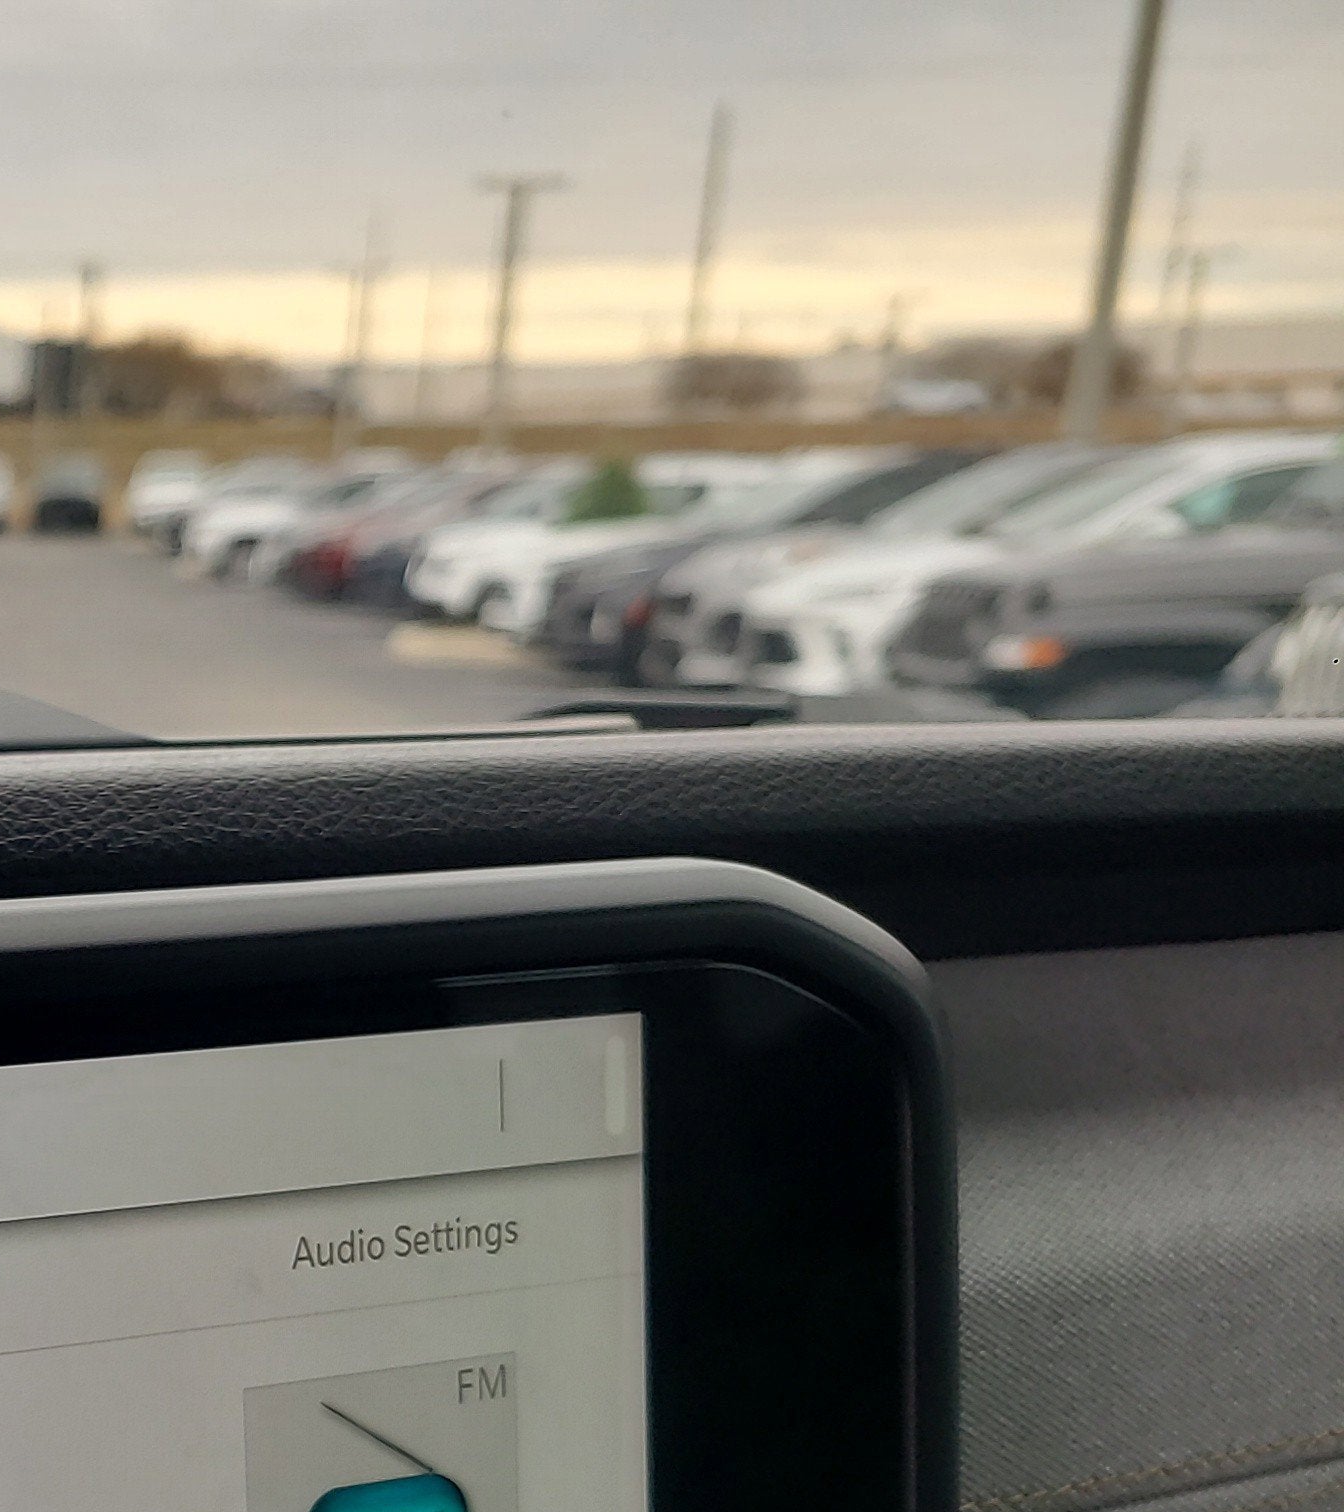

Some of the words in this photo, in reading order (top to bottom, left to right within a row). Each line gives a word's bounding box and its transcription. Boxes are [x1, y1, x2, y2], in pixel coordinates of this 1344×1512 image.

[292, 1228, 385, 1269] Audio
[393, 1216, 519, 1256] Settings
[458, 1364, 507, 1404] FM
